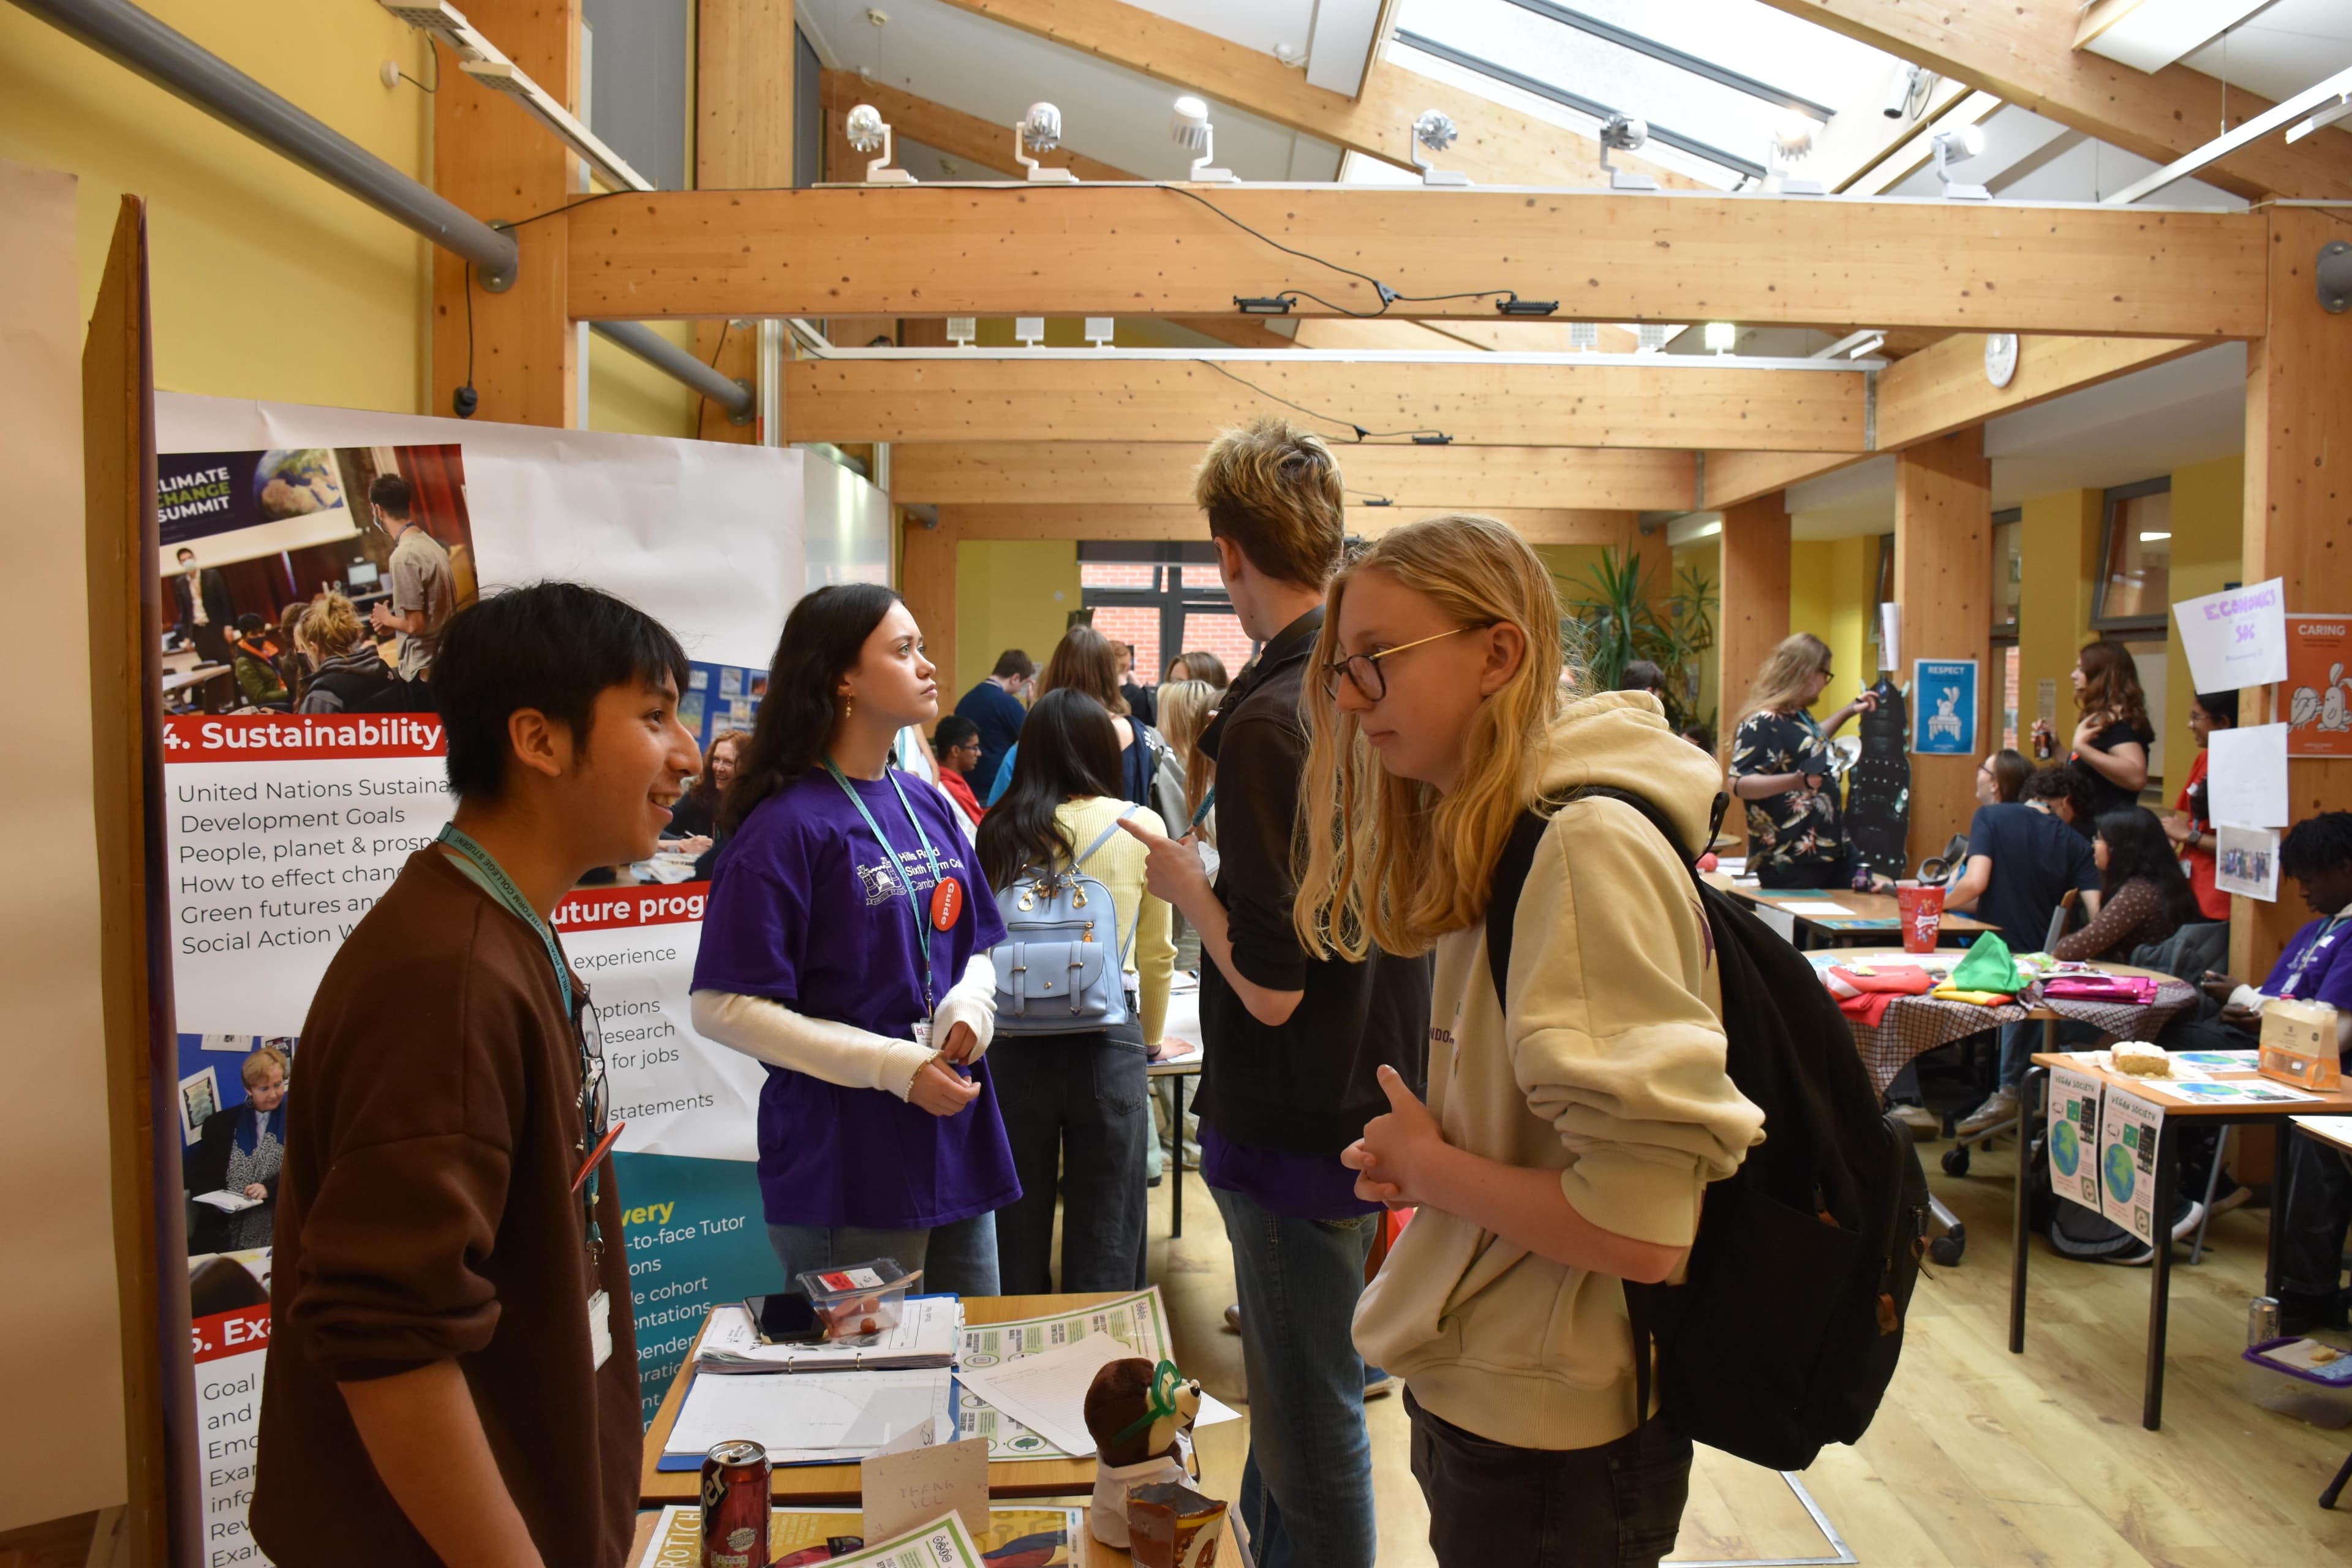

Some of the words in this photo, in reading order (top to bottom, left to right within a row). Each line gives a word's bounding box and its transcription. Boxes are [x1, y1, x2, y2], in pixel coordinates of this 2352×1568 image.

[157, 467, 230, 492] LIMATE
[157, 496, 230, 522] SUMMIT
[2298, 624, 2345, 636] CARING
[1928, 666, 1965, 674] RESPECT
[202, 718, 442, 752] Sustainability
[178, 782, 258, 803] United
[266, 780, 353, 800] Nations
[181, 809, 339, 834] Development
[345, 805, 405, 826] Goals
[179, 842, 266, 866] People,
[274, 837, 344, 861] planet
[352, 836, 366, 854] &
[454, 834, 486, 861] STUDENT
[898, 852, 917, 862] Hills
[916, 846, 941, 859] Rd
[181, 874, 235, 895] How
[241, 872, 265, 890] to
[271, 868, 336, 888] effect
[483, 860, 515, 894] COLLEGE
[905, 864, 927, 876] Sixth
[926, 861, 949, 872] Frm
[181, 901, 252, 924] Green
[259, 897, 341, 919] futures
[513, 894, 533, 918] FORM
[941, 883, 954, 925] Guide
[183, 931, 250, 954] Social
[258, 927, 331, 949] Action
[574, 948, 676, 971] experience
[594, 1000, 661, 1022] options
[612, 1053, 636, 1069] for
[640, 1048, 679, 1069] jobs
[610, 1093, 714, 1121] statements
[2132, 1104, 2156, 1121] SOCIETY
[624, 1226, 695, 1250] -to-face
[700, 1215, 745, 1237] Tutor
[649, 1276, 708, 1301] cohort
[204, 1373, 255, 1400] Goal
[208, 1403, 252, 1430] and
